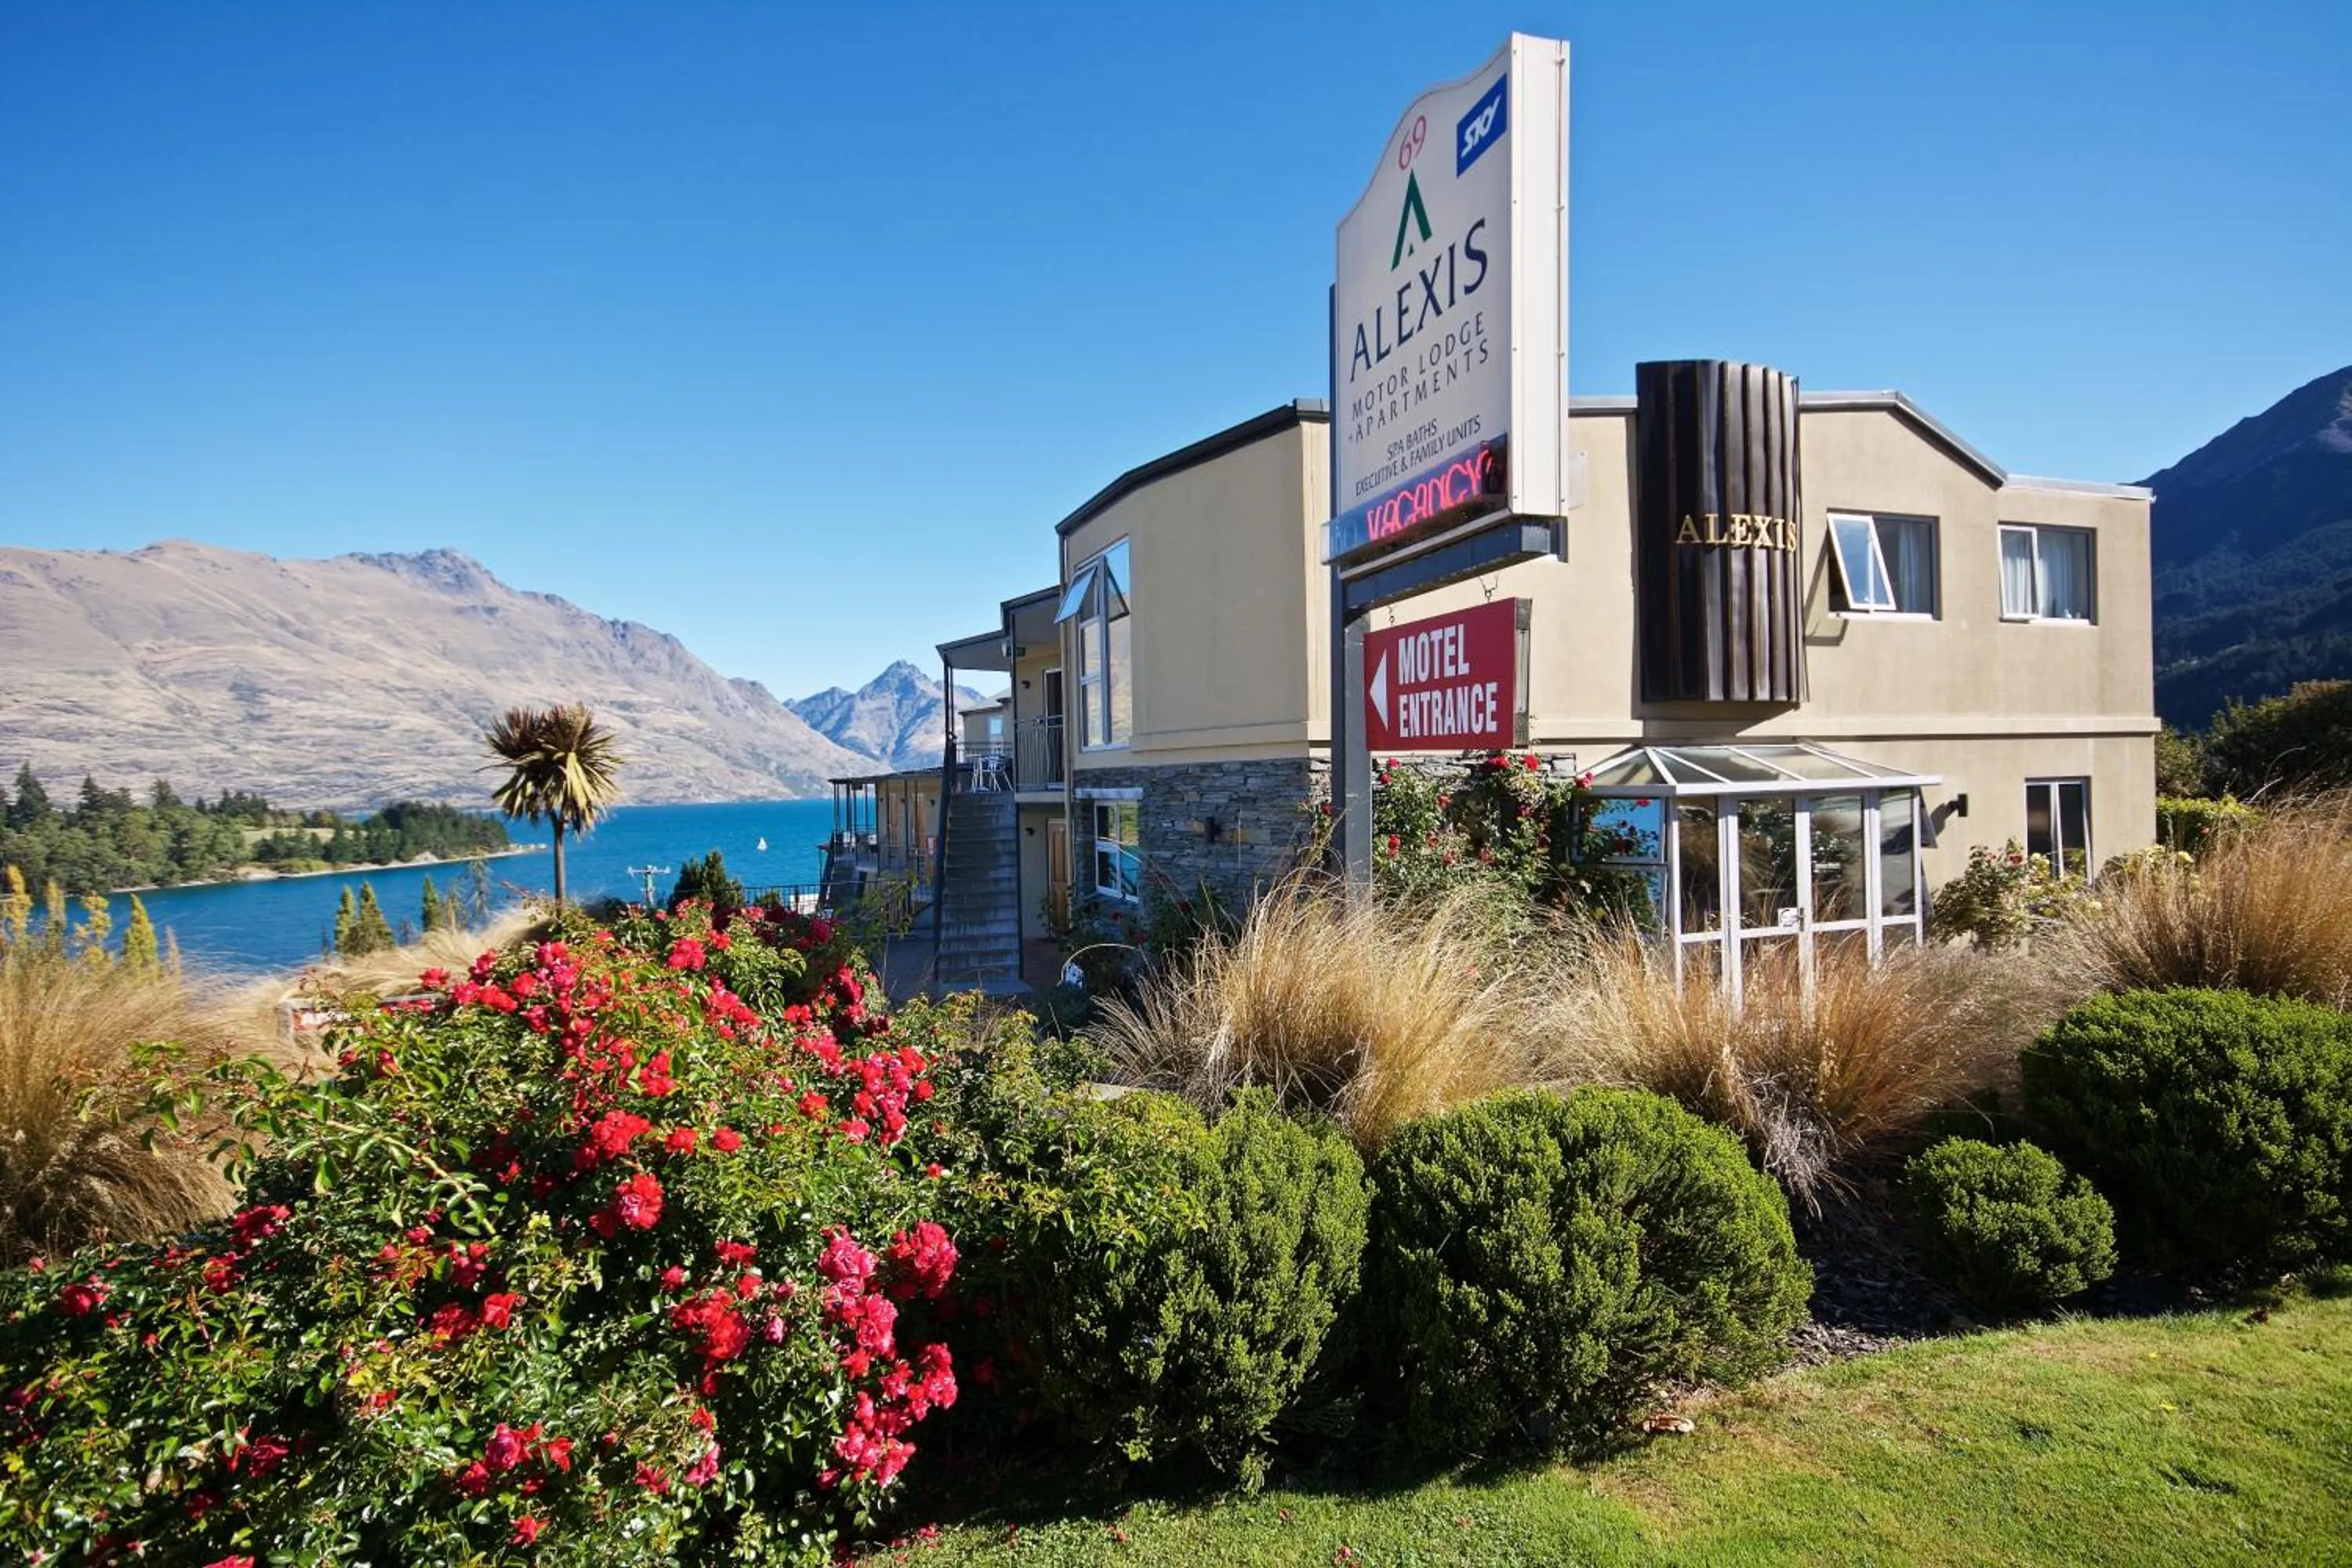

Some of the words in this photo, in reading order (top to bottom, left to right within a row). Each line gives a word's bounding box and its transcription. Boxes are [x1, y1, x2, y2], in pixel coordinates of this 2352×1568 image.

[1398, 114, 1427, 171] 69
[1461, 93, 1502, 159] SKY
[1349, 216, 1488, 383] ALEXIS
[1352, 365, 1408, 421] MOTOR
[1419, 311, 1484, 376] LODGE
[1356, 338, 1489, 444] APARTMENTS
[1355, 460, 1399, 497] EXECUTIVE
[1400, 456, 1409, 474] &
[1410, 433, 1446, 469] FAMILY
[1446, 414, 1482, 448] UNITS
[1386, 438, 1405, 461] SPA
[1406, 417, 1438, 451] BATHS
[1367, 449, 1490, 541] VACANCY
[1675, 514, 1797, 554] ALEXIS
[1398, 623, 1470, 685] MOTEL
[1398, 681, 1499, 738] ENTRANCE
